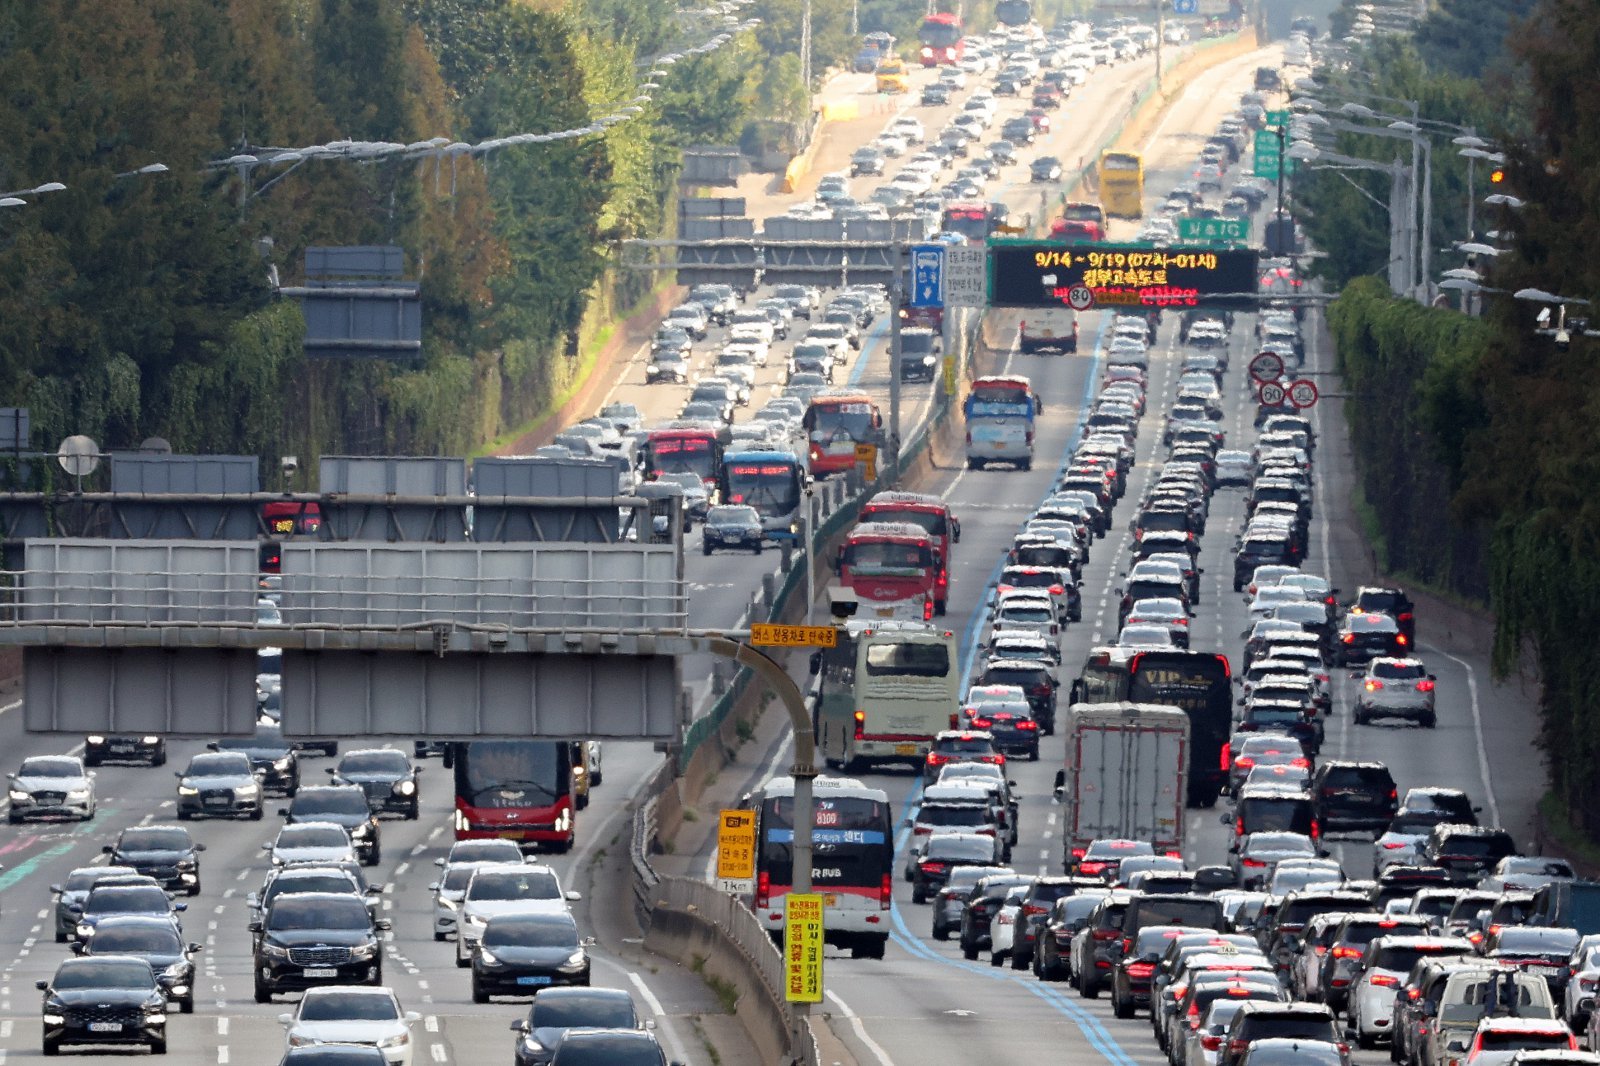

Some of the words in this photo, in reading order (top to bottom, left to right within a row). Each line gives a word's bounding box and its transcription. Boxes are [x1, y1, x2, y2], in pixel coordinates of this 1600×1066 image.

[1035, 251, 1071, 268] 9/14
[1088, 251, 1126, 268] 9/19
[1071, 289, 1089, 302] 80
[1264, 387, 1282, 401] 60
[773, 628, 806, 643] 전용차로
[1145, 670, 1180, 684] VIP
[816, 811, 837, 825] 8100
